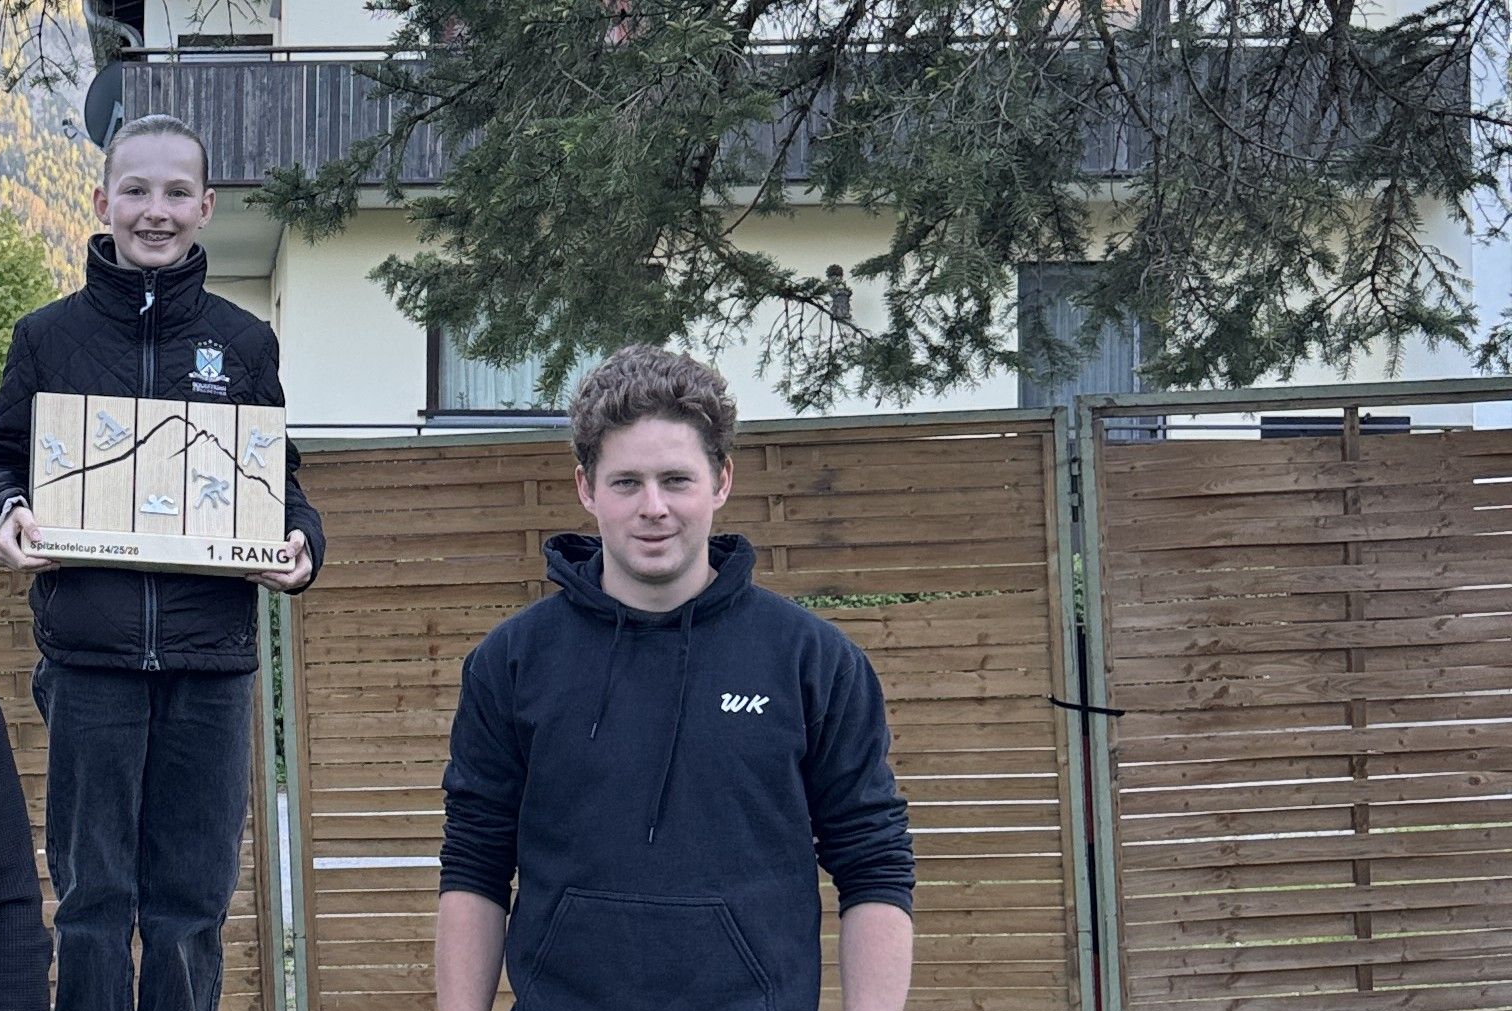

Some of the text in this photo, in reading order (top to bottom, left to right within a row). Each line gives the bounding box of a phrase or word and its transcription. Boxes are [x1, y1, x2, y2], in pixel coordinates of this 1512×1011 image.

[207, 544, 291, 564] 1. RANG
[721, 692, 770, 714] WK
